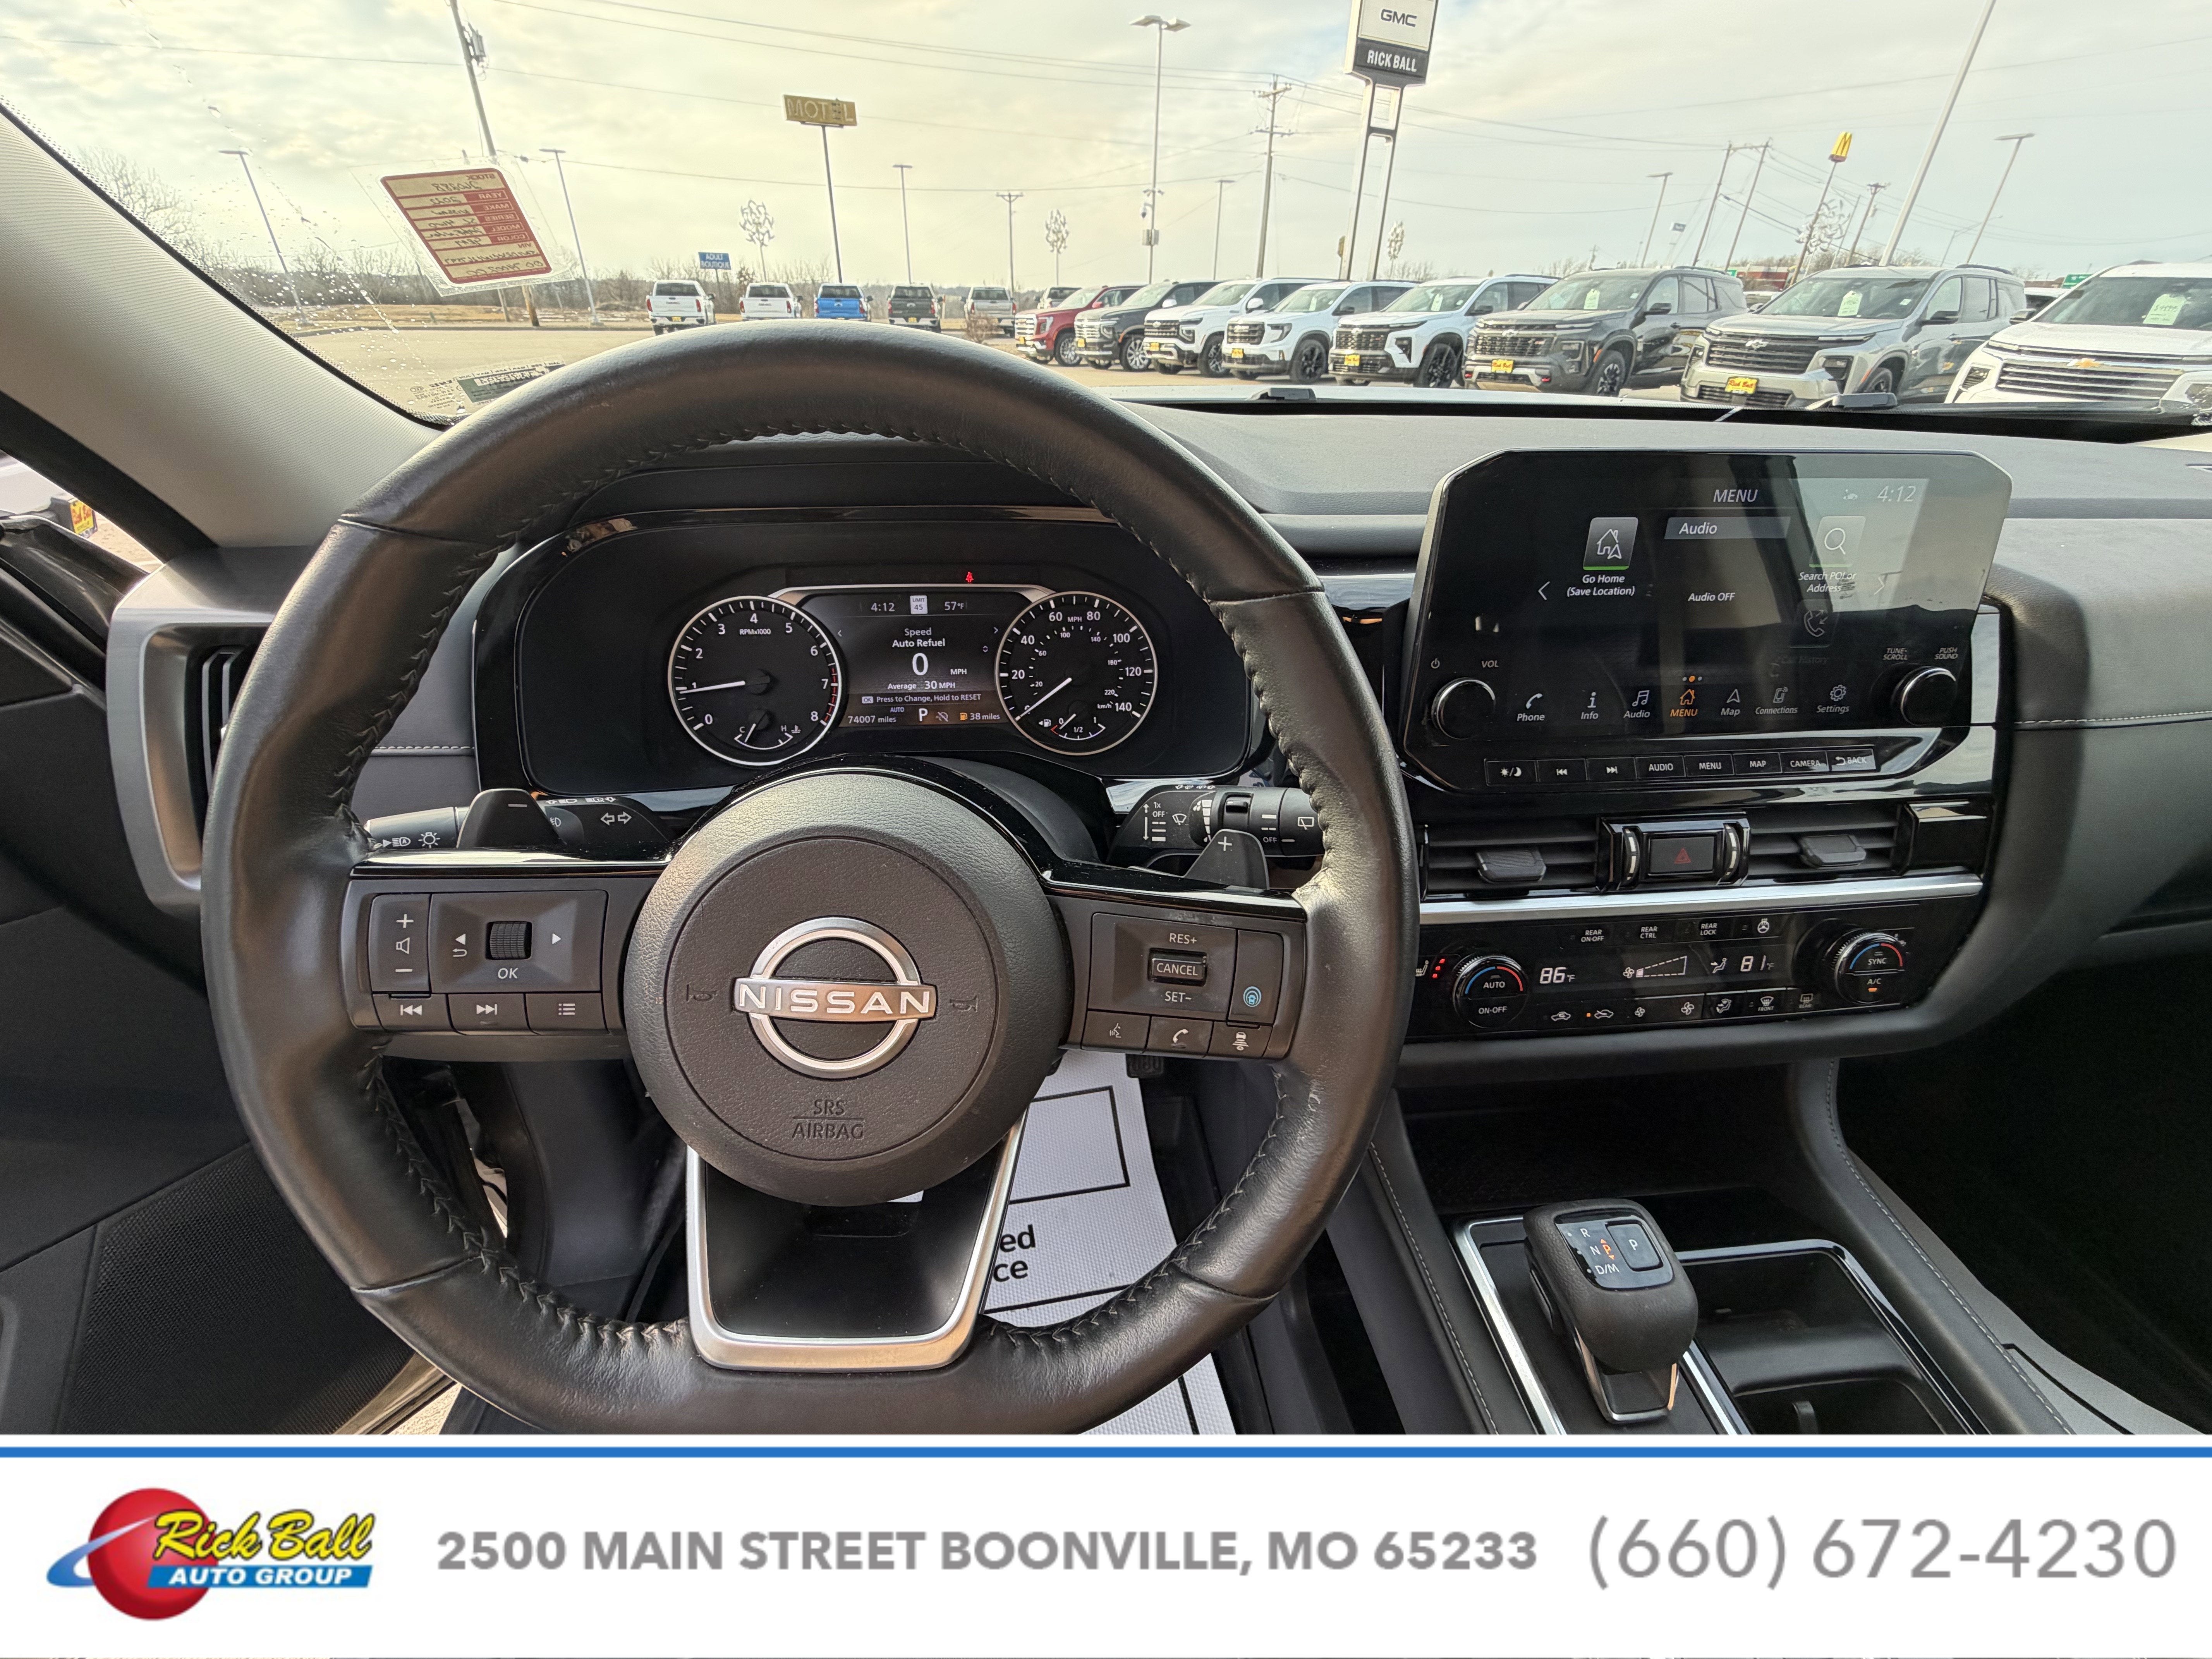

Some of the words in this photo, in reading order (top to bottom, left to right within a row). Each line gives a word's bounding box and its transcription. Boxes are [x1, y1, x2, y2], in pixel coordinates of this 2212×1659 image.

[1381, 9, 1417, 27] GMC
[1367, 50, 1391, 68] RICK
[1393, 55, 1417, 72] BALL
[787, 98, 854, 122] MOTEL
[1713, 488, 1759, 503] MENU
[1877, 485, 1917, 503] 4:12
[1679, 522, 1718, 535] Audio
[1582, 574, 1595, 584] Go
[1597, 574, 1625, 583] Home
[1798, 572, 1828, 580] Search
[1566, 586, 1591, 598] (Save
[1592, 585, 1636, 597] Location)
[1806, 583, 1841, 592] Address
[1687, 592, 1716, 602] Audio
[1717, 592, 1736, 601] OFF
[871, 602, 895, 612] 4:12
[944, 601, 965, 611] 57°F
[750, 613, 758, 623] 4
[1048, 611, 1063, 622] 60
[1086, 611, 1101, 621] 80
[718, 623, 726, 635] 3
[785, 623, 793, 633] 5
[904, 627, 932, 637] Speed
[892, 639, 915, 648] Auto
[917, 638, 946, 647] Refuel
[1020, 635, 1035, 645] 40
[1113, 633, 1130, 643] 100
[695, 648, 703, 659] 2
[810, 645, 818, 656] 6
[912, 653, 929, 676] 0
[1481, 660, 1499, 668] VOL
[1011, 670, 1025, 680] 20
[1125, 666, 1142, 677] 120
[821, 678, 829, 689] 7
[924, 680, 938, 689] 30
[904, 695, 933, 704] Change,
[1115, 702, 1132, 712] 140
[1721, 707, 1741, 717] Map
[1755, 706, 1798, 714] Connections
[1816, 703, 1850, 714] Settings
[811, 711, 819, 722] 8
[919, 708, 928, 722] P
[970, 713, 981, 721] 38
[1516, 712, 1545, 721] Phone
[1580, 711, 1599, 720] Info
[1623, 709, 1650, 718] Audio
[1670, 709, 1698, 718] MENU
[704, 714, 713, 725] 0
[847, 715, 876, 724] 74007
[878, 715, 896, 723] miles
[1749, 759, 1767, 768] MAP
[1790, 759, 1821, 768] CAMERA
[1846, 756, 1867, 764] BACK
[1649, 763, 1674, 771] AUDIO
[1699, 761, 1722, 770] MENU
[1169, 933, 1197, 944] RES+
[1868, 957, 1887, 965] SYNC
[497, 968, 518, 979] OK
[1156, 962, 1198, 976] CANCEL
[738, 983, 930, 1015] NISSAN
[814, 1099, 846, 1116] SRS
[792, 1122, 865, 1140] AIRBAG
[1580, 1228, 1590, 1238] R
[1589, 1245, 1601, 1255] N
[1602, 1244, 1612, 1255] P
[1628, 1239, 1638, 1251] P
[1594, 1263, 1620, 1275] D/M
